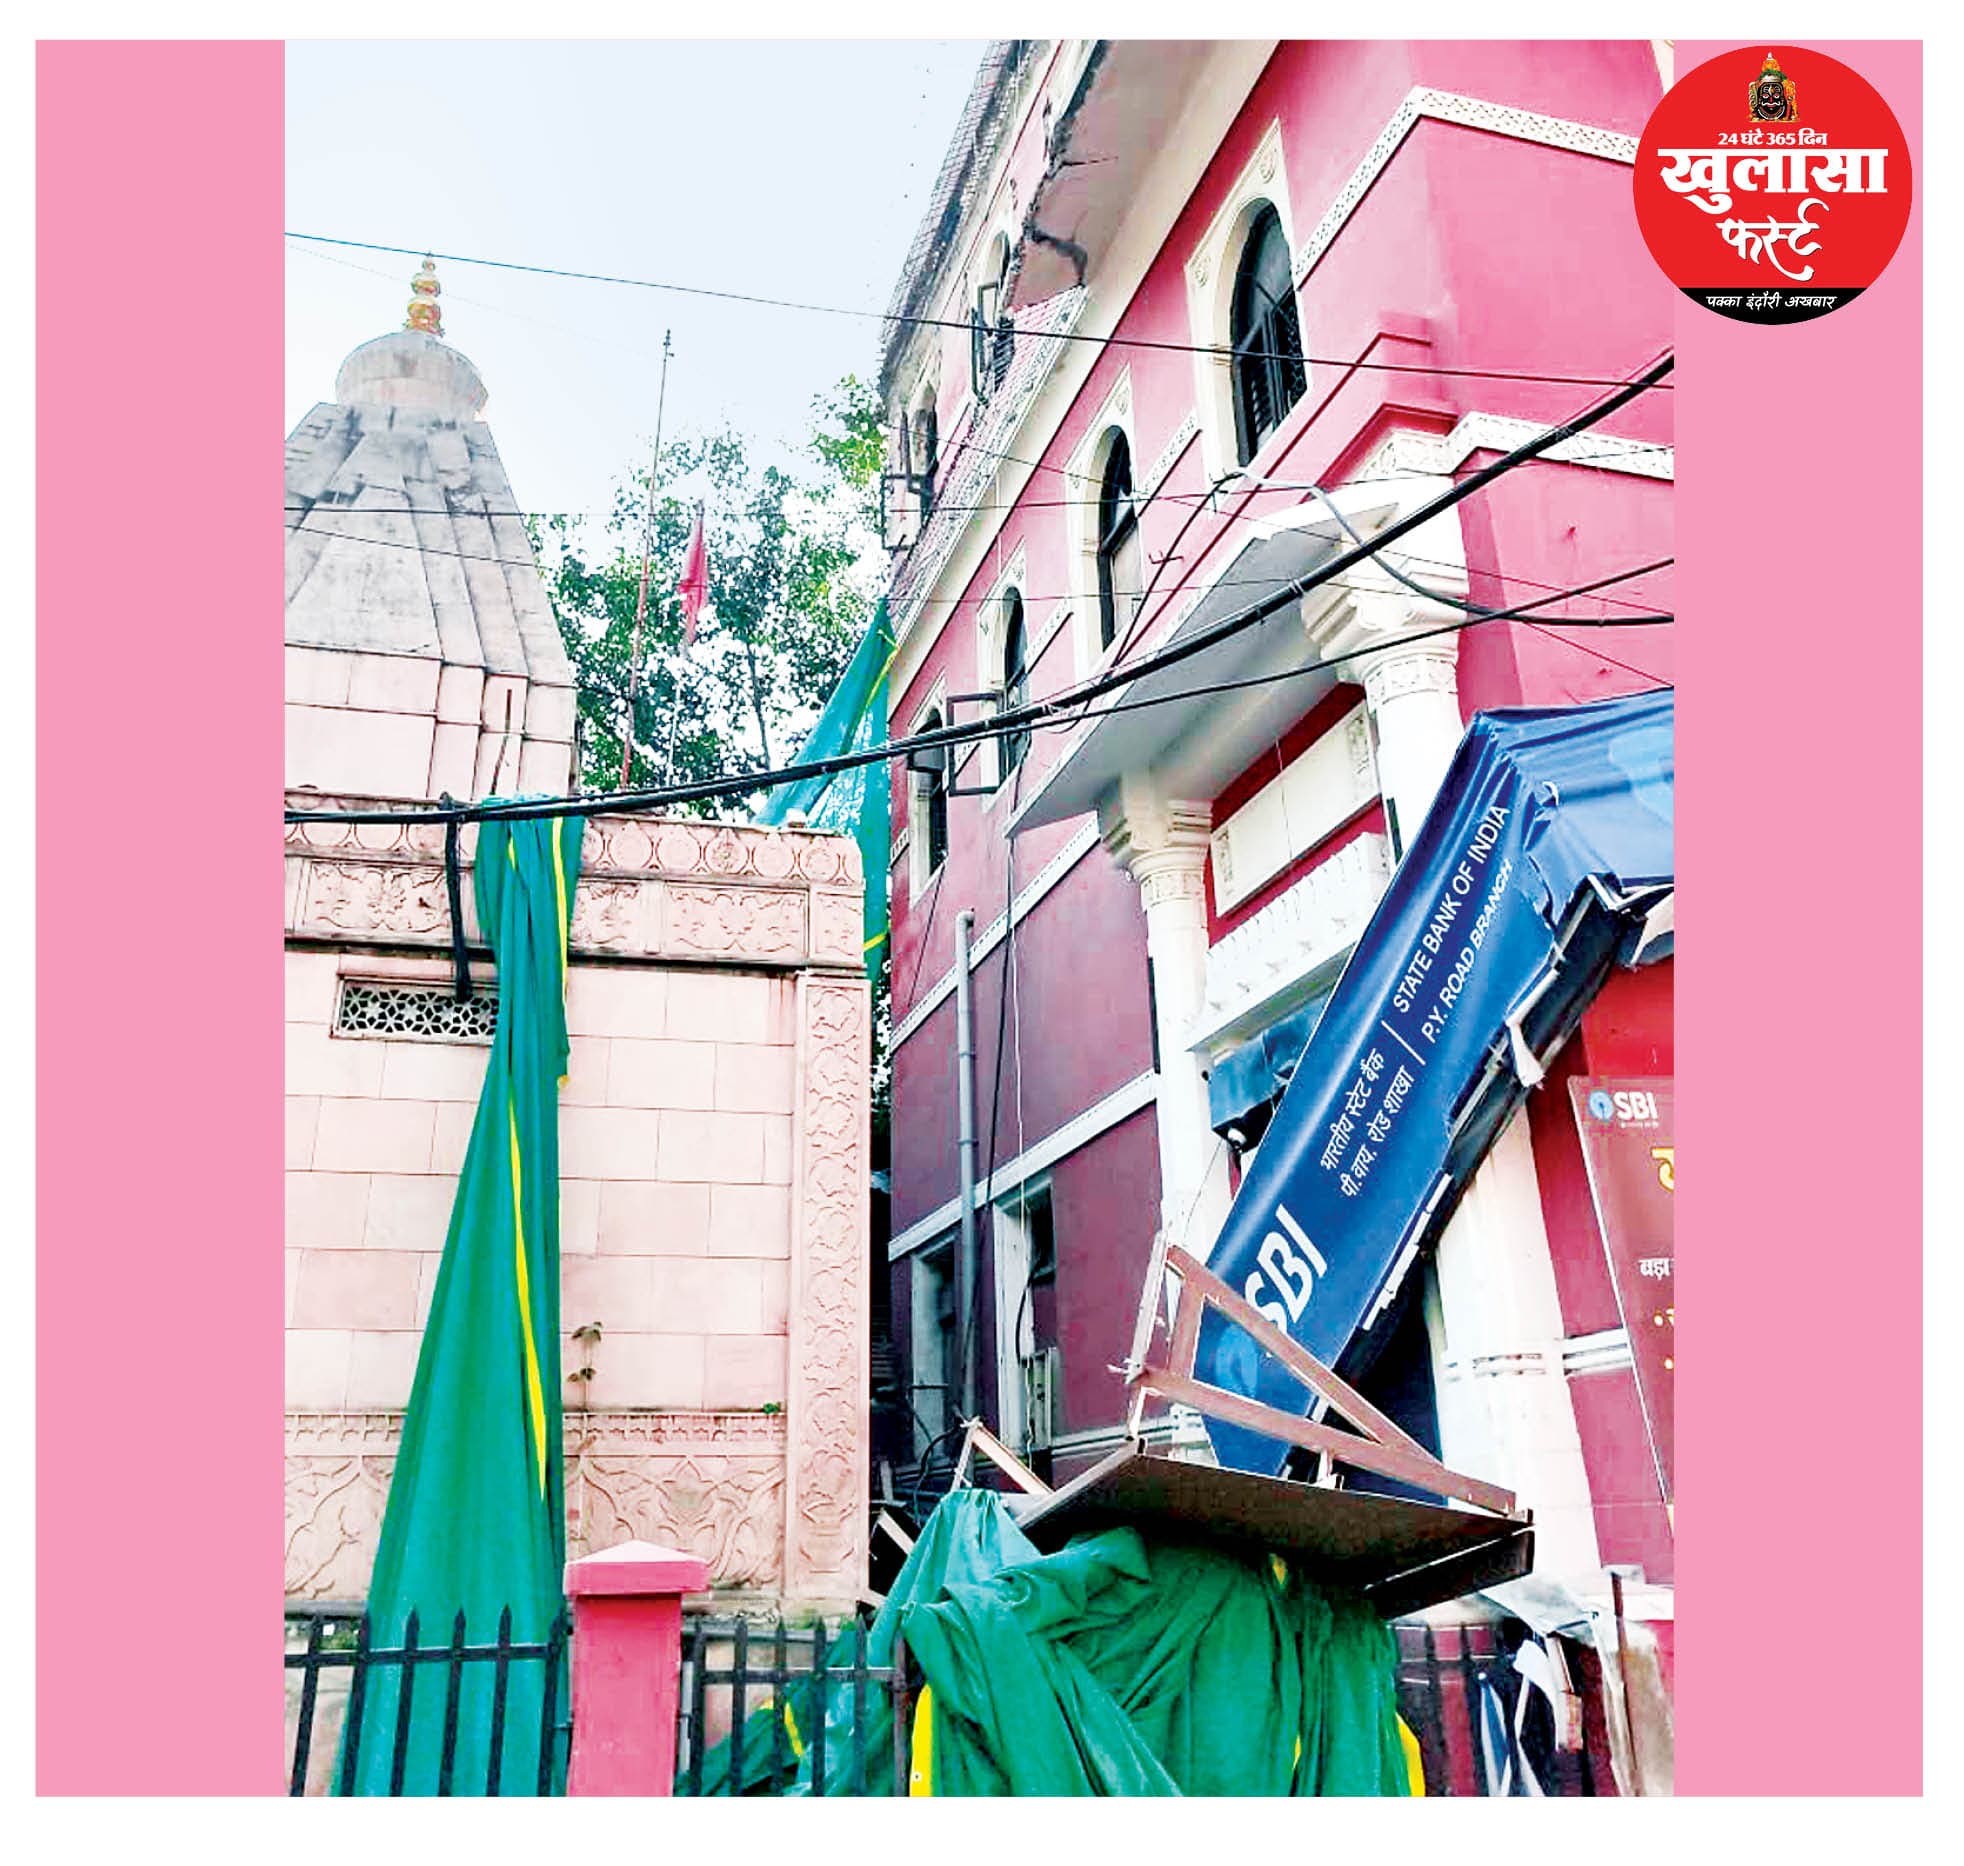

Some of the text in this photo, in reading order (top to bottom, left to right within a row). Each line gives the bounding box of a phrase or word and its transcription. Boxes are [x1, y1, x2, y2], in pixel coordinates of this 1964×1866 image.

[1393, 805, 1511, 1013] STATE BANK OF INDIA
[1421, 858, 1512, 1043] P.Y. ROAD BRANCH
[1320, 1048, 1384, 1170] भारतीय स्टेट बैंक
[1366, 1110, 1391, 1142] रोड
[1383, 1065, 1415, 1114] शाखा
[1613, 1091, 1658, 1121] SBI
